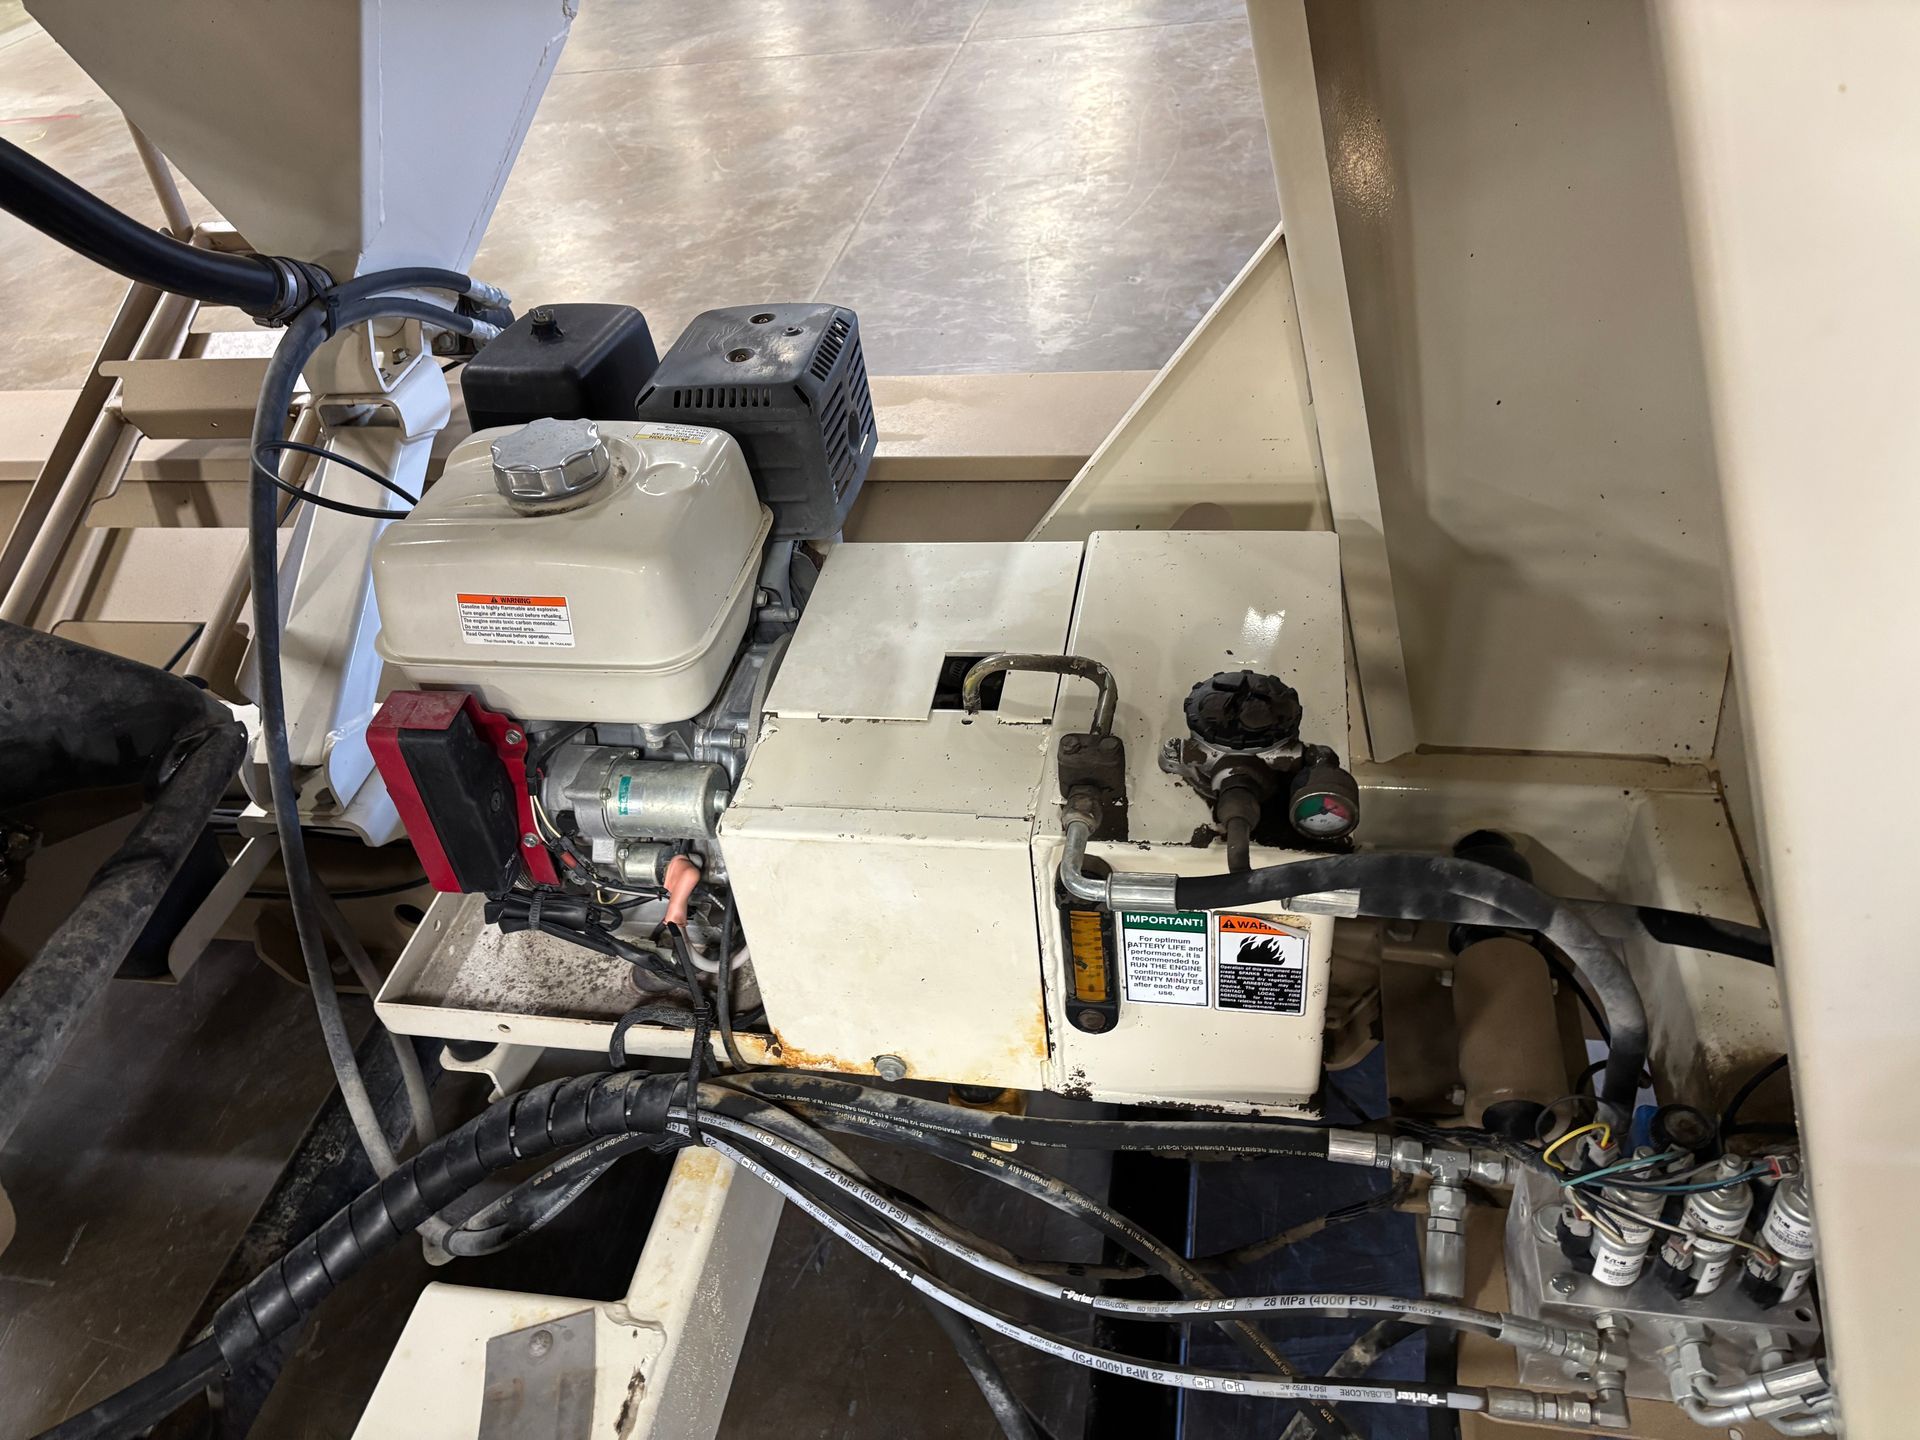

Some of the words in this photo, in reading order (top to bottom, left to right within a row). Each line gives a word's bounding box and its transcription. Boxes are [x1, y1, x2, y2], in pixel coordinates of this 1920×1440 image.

[1126, 915, 1204, 927] IMPORTANT!
[1128, 941, 1166, 950] BATTERY
[1155, 937, 1191, 945] optimum
[1131, 949, 1184, 958] performance,
[1132, 956, 1189, 965] recommended
[1169, 964, 1202, 972] ENGINE
[1134, 969, 1185, 978] continuously
[1165, 977, 1204, 985] MINUTES
[706, 1137, 718, 1147] 28
[824, 1167, 837, 1180] 28
[837, 1175, 859, 1194] MPa
[860, 1189, 887, 1210] (4000
[887, 1205, 909, 1224] PSI)
[1063, 1290, 1094, 1305] Parker
[1095, 1299, 1129, 1310] GLOBALCORE
[1264, 1297, 1276, 1307] 28
[1280, 1297, 1305, 1306] MPa
[1309, 1296, 1345, 1307] (4000
[1349, 1296, 1377, 1307] PSI)
[1071, 1351, 1093, 1366] PSI)
[1095, 1360, 1124, 1376] (4000
[1126, 1366, 1149, 1379] MPa
[1152, 1372, 1165, 1383] 28
[1313, 1385, 1327, 1393] ISO
[1340, 1388, 1393, 1399] GLOBALCORE
[1396, 1391, 1447, 1406] Parker
